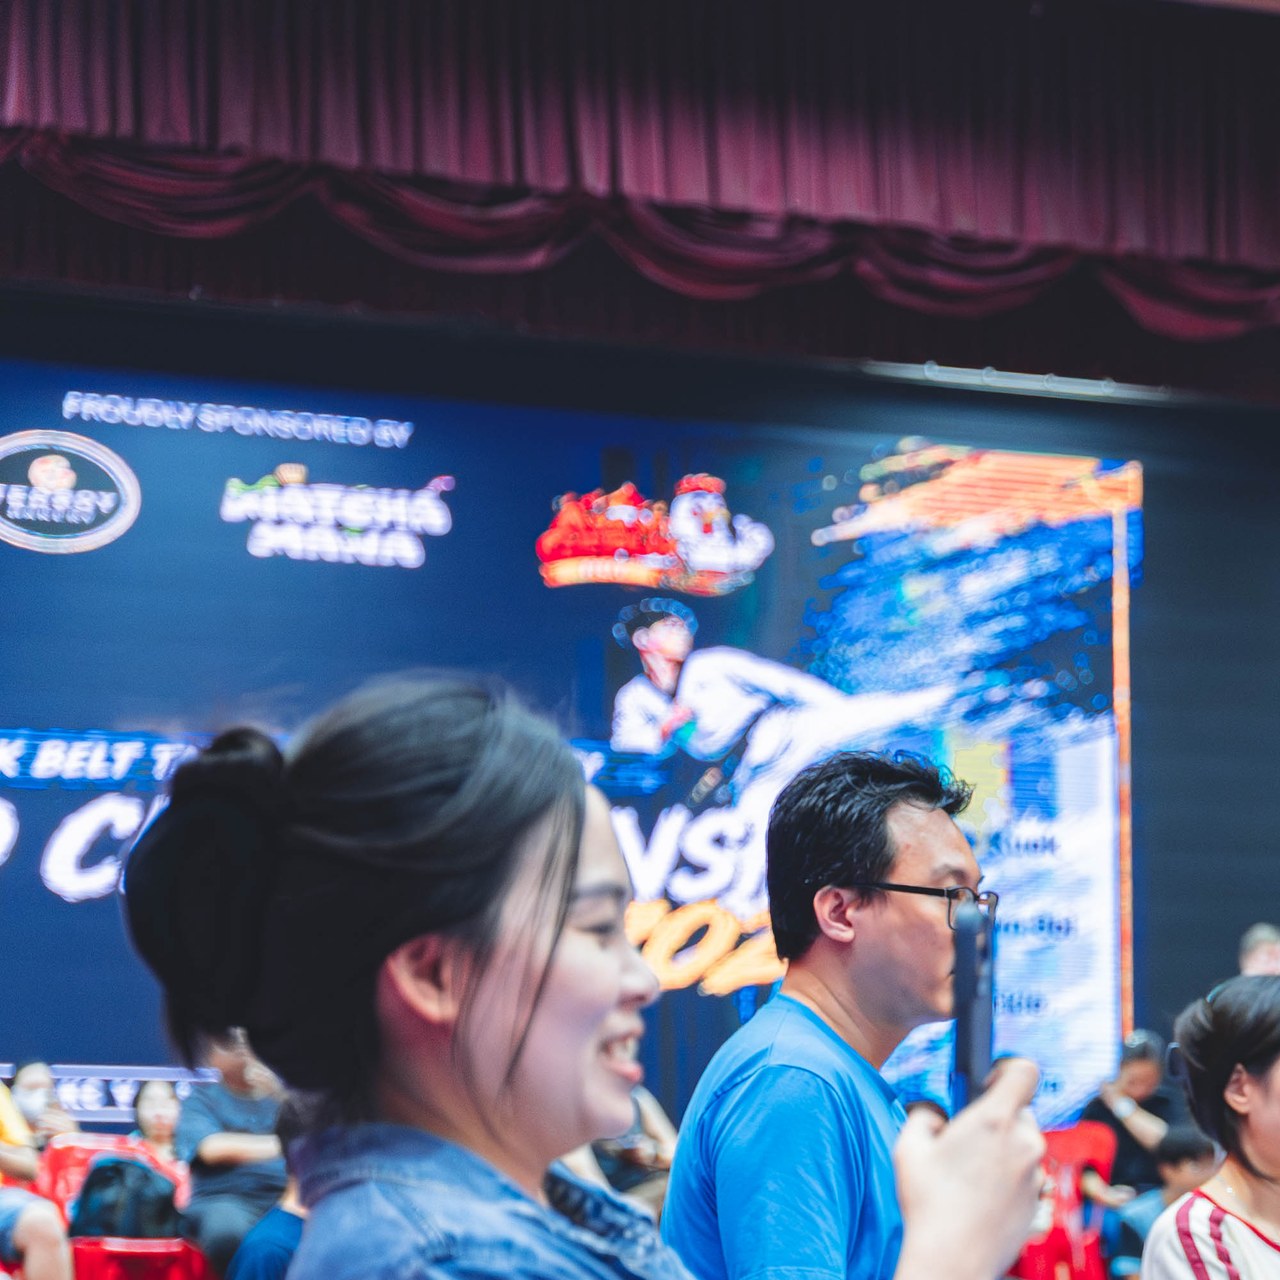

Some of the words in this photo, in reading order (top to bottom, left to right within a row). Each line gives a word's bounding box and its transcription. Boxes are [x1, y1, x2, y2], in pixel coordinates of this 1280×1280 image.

[63, 391, 198, 430] PROUDLY
[197, 403, 373, 446] SPONSORED
[29, 738, 146, 780] BELT
